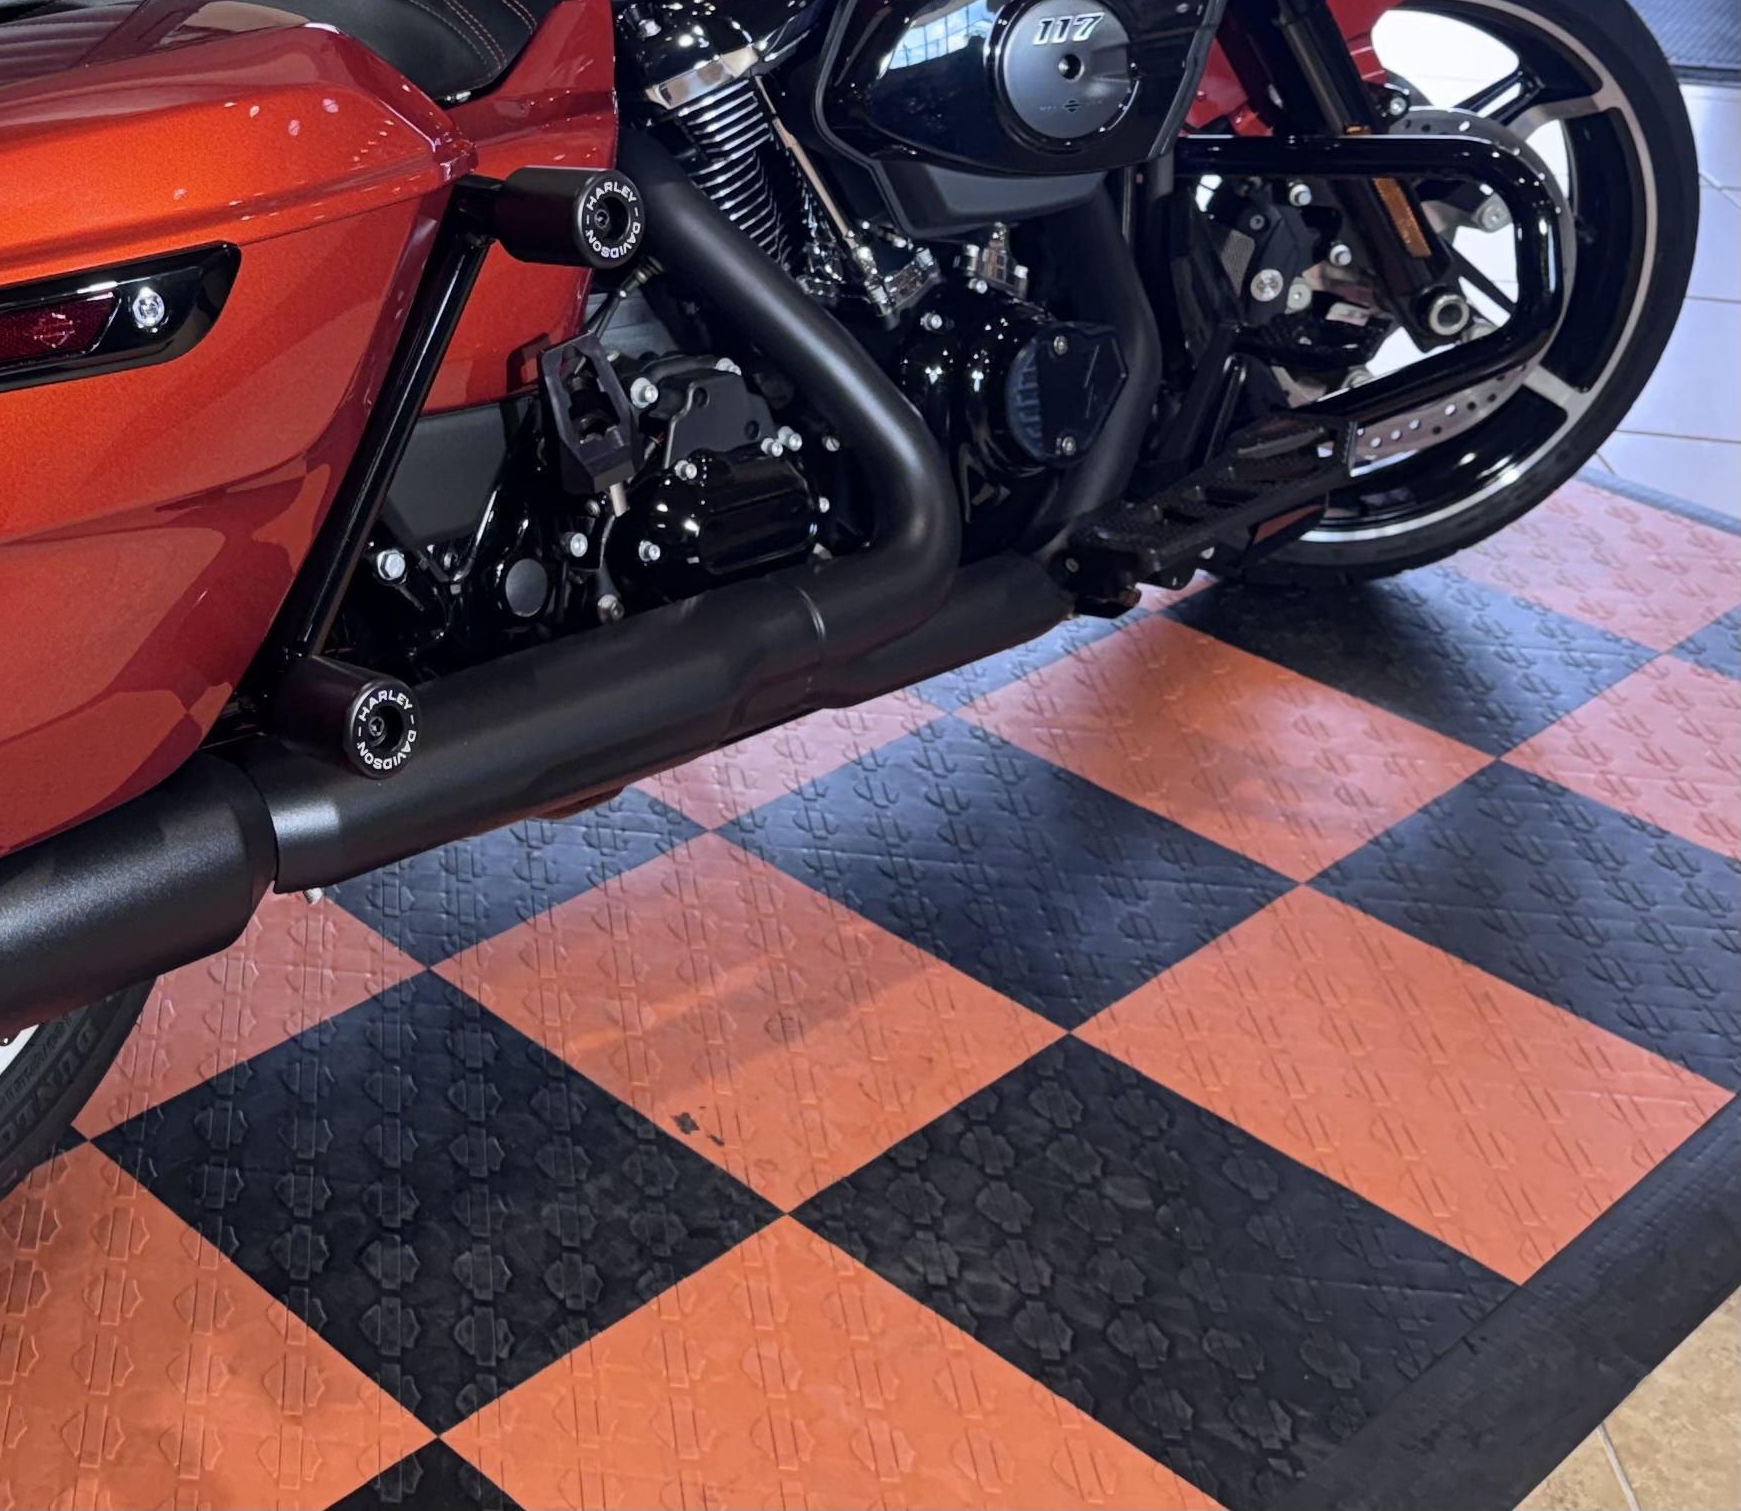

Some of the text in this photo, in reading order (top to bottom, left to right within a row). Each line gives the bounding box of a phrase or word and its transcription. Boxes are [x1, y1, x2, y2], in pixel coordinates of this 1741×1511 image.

[1033, 11, 1106, 45] 117
[585, 181, 641, 258] HARLEY DAVIDSON
[356, 690, 417, 770] HARLEY DAVIDSON
